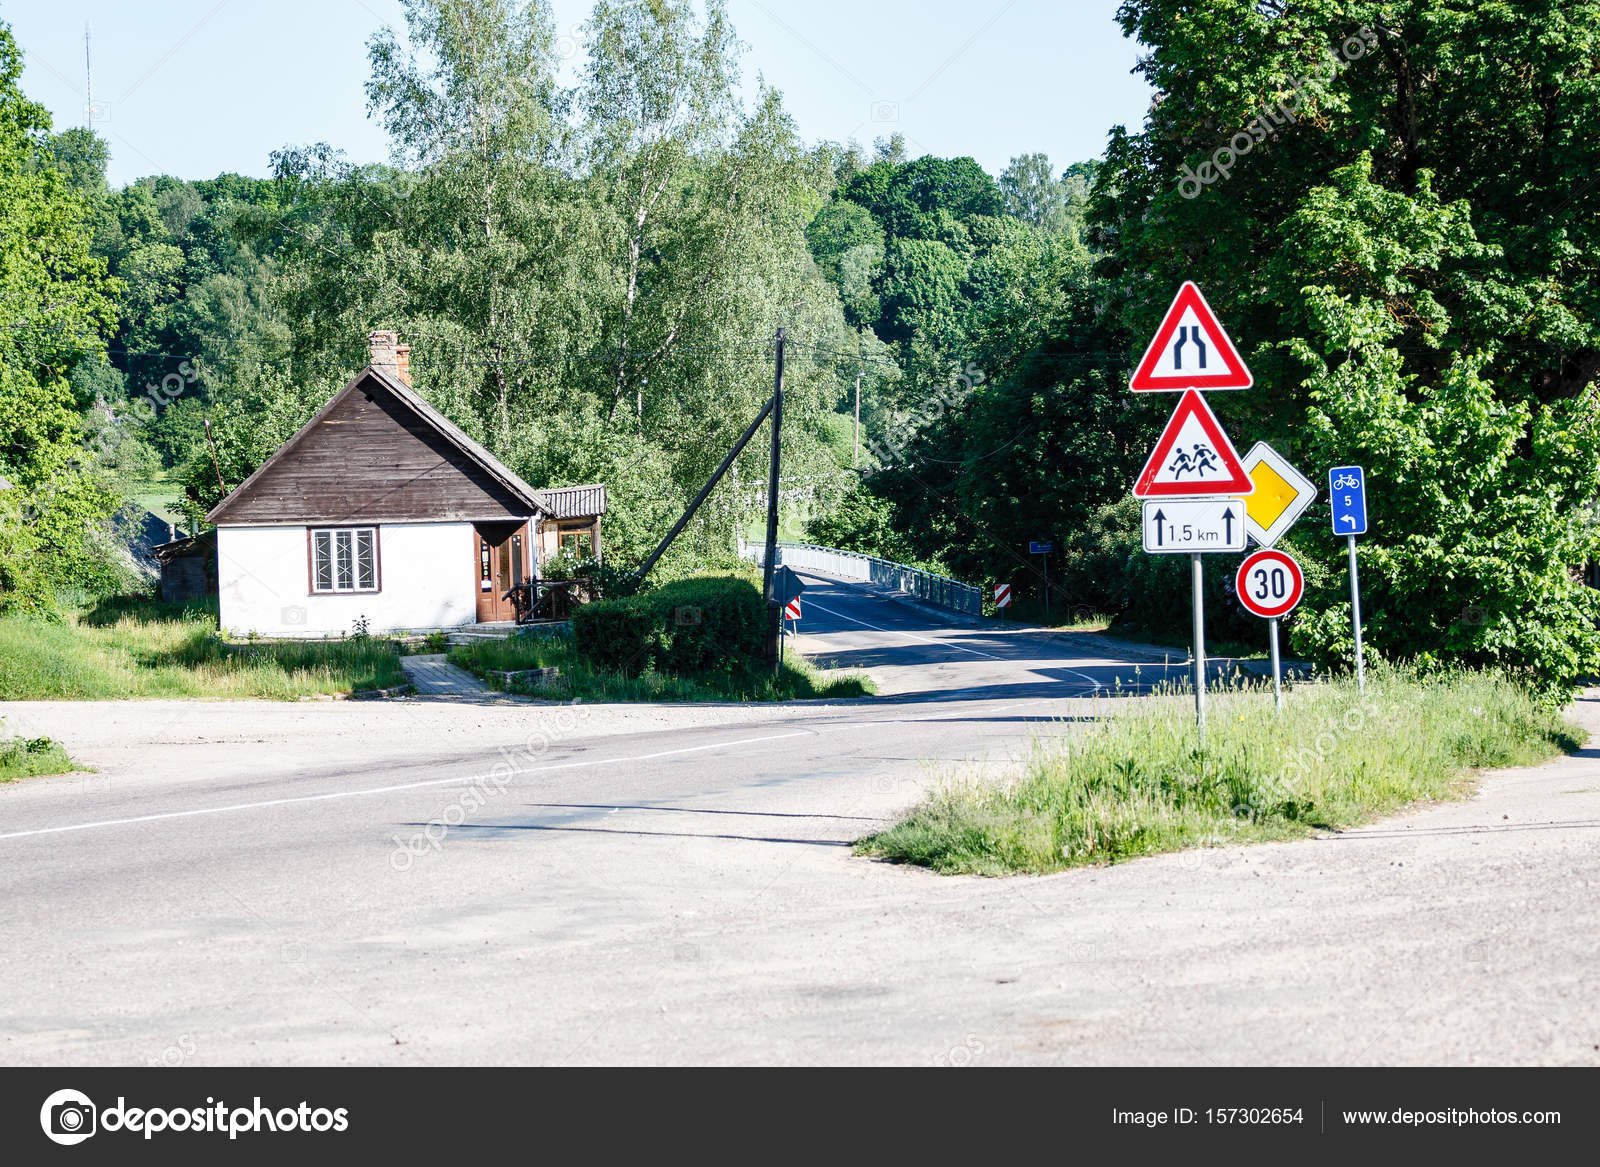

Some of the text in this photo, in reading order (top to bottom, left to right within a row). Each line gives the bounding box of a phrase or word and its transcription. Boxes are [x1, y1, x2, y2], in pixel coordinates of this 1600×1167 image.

[1344, 495, 1352, 507] 5
[1169, 525, 1218, 542] 1.5 km
[1254, 568, 1285, 599] 30
